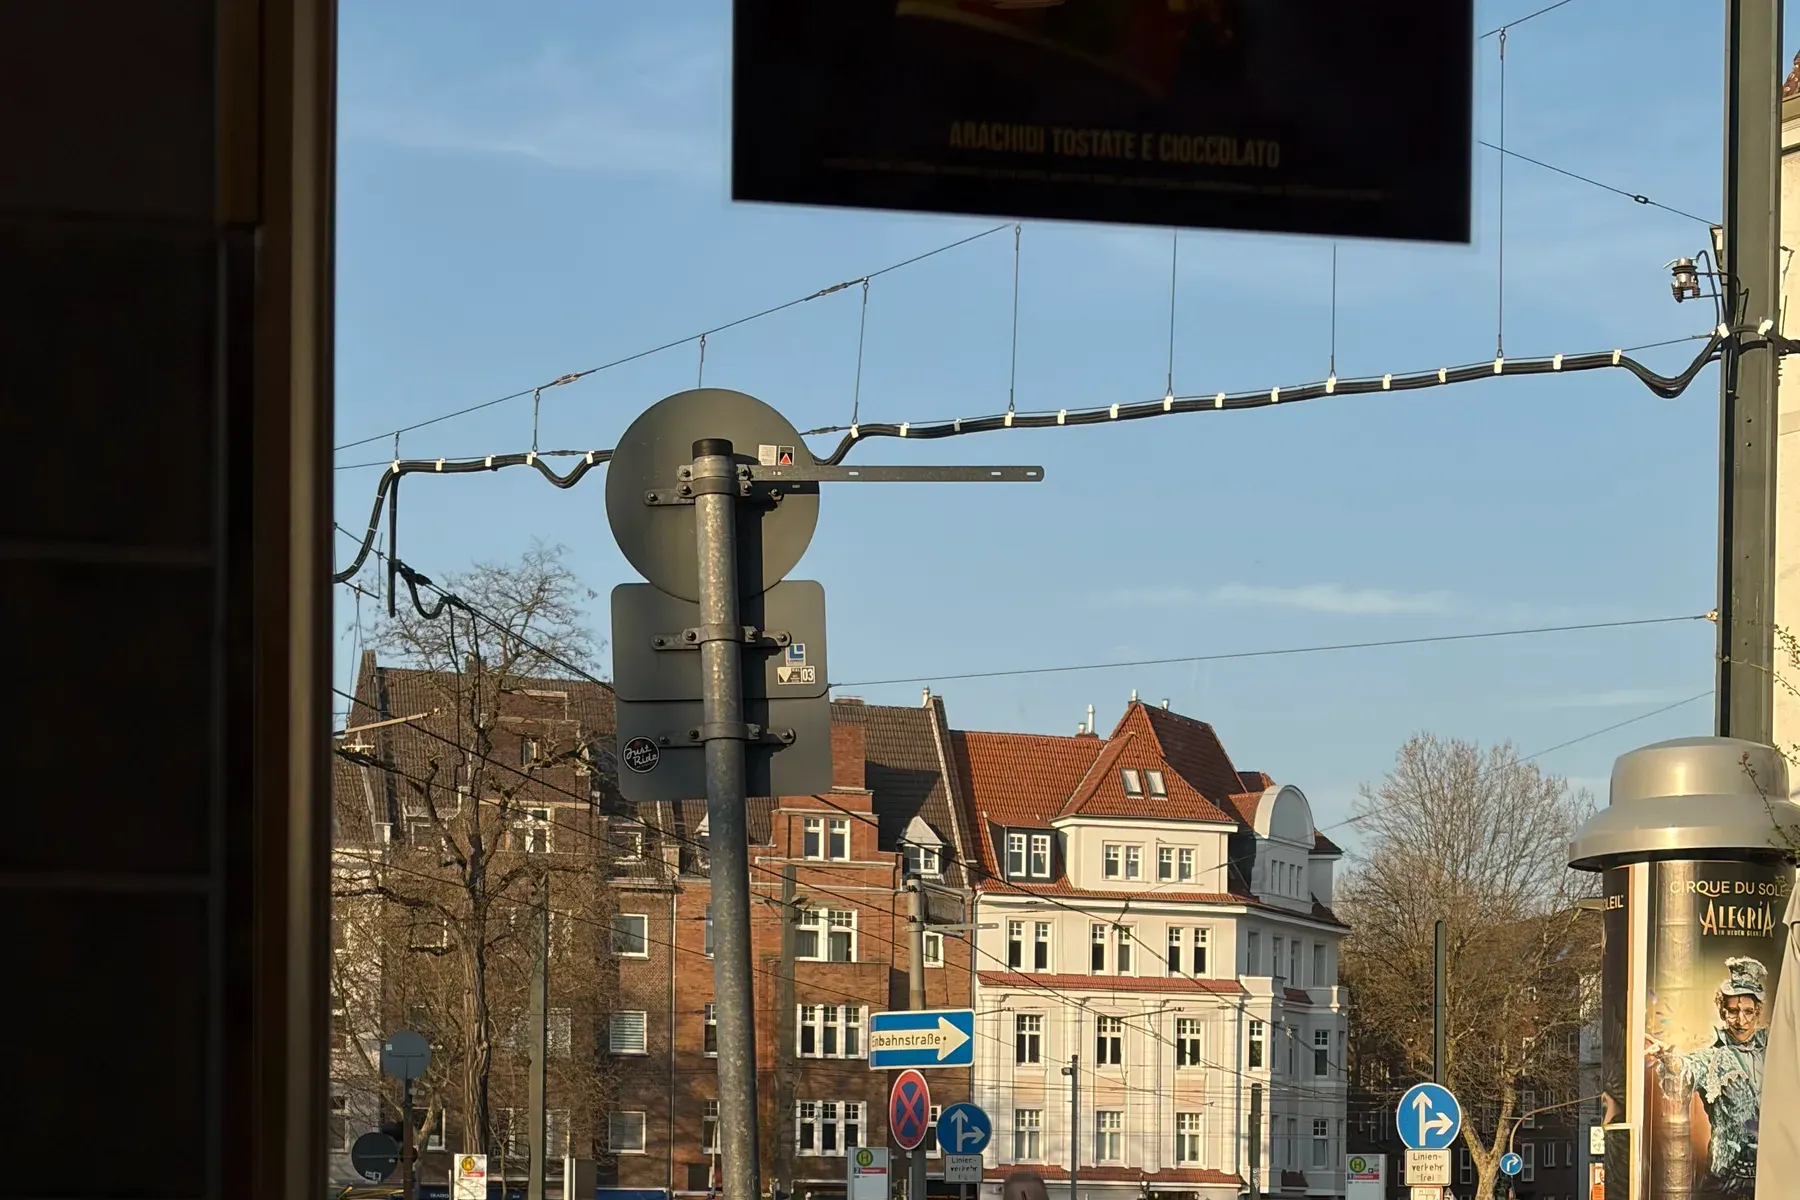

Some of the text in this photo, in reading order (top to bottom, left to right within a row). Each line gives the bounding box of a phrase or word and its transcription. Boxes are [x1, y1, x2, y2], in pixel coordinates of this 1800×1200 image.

[948, 121, 1281, 169] ARACHIDI TOSTATE E CIOCCOLATO
[802, 668, 814, 681] 03
[625, 744, 652, 760] Just
[633, 753, 659, 766] Ride
[1669, 880, 1730, 898] CIRQUE
[1735, 881, 1755, 895] DU
[1412, 1152, 1442, 1161] Linien-
[1411, 1163, 1445, 1172] verkehr
[1420, 1173, 1435, 1182] frei
